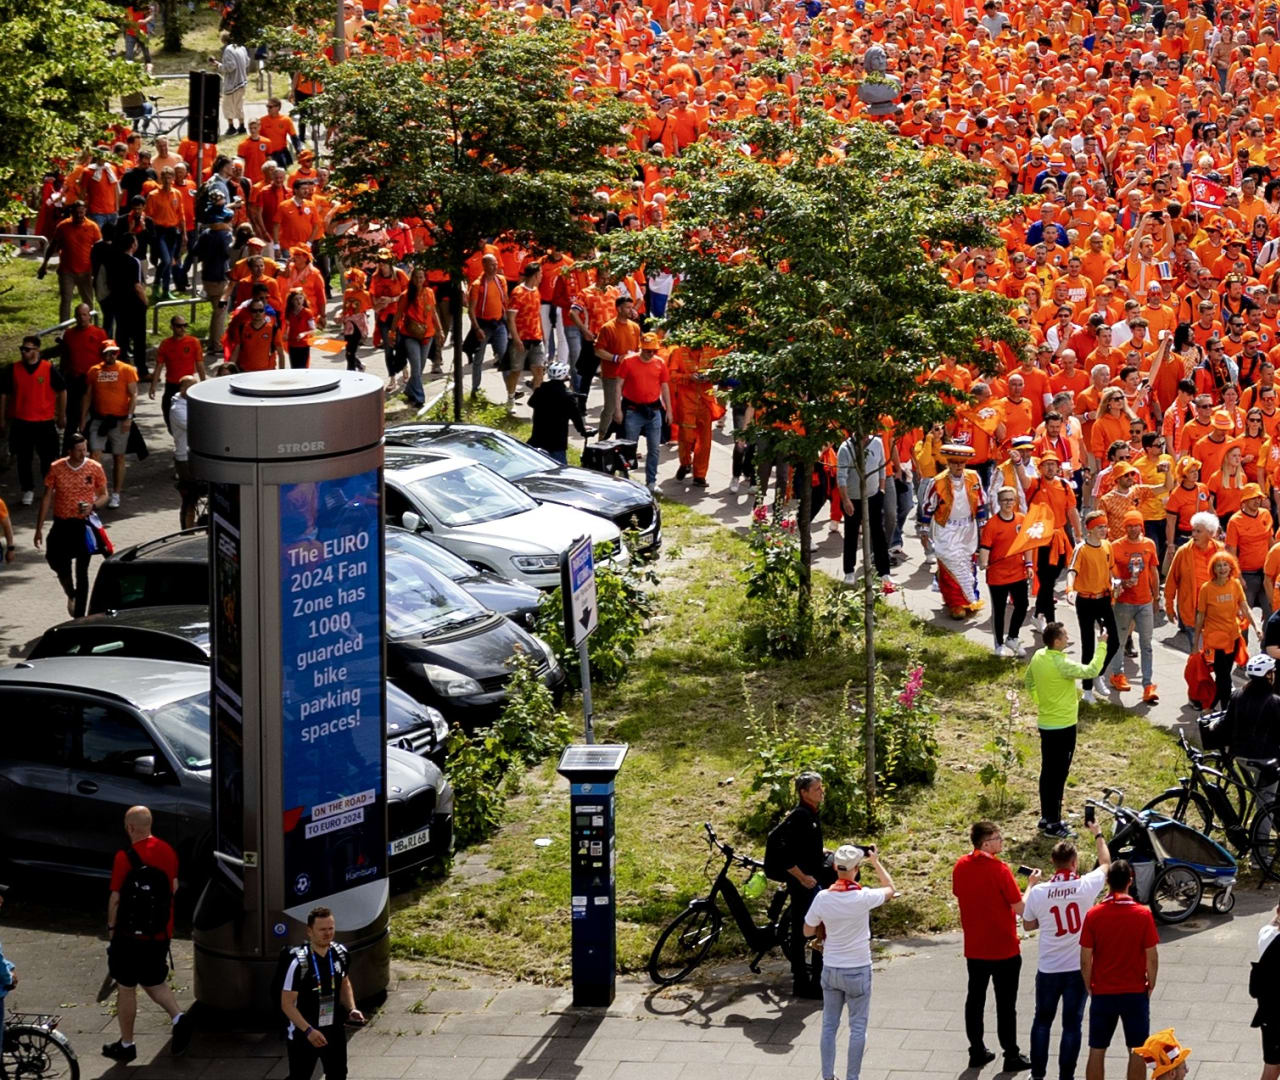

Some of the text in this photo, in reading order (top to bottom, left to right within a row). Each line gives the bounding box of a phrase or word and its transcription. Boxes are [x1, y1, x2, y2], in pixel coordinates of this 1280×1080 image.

[288, 531, 369, 567] The EURO
[291, 560, 367, 593] 2024 Fan
[292, 586, 366, 617] Zone has
[308, 611, 351, 639] 1000
[296, 633, 363, 671] guarded
[313, 667, 347, 688] bike
[300, 687, 361, 720] parking
[300, 709, 361, 743] spaces!
[313, 806, 326, 817] ON
[327, 800, 343, 813] THE
[344, 794, 367, 808] ROAD
[308, 811, 362, 835] TO EURO 2024
[393, 841, 404, 853] HB
[345, 866, 377, 881] Hamburg
[1047, 887, 1077, 899] klupa
[1049, 902, 1082, 937] 10
